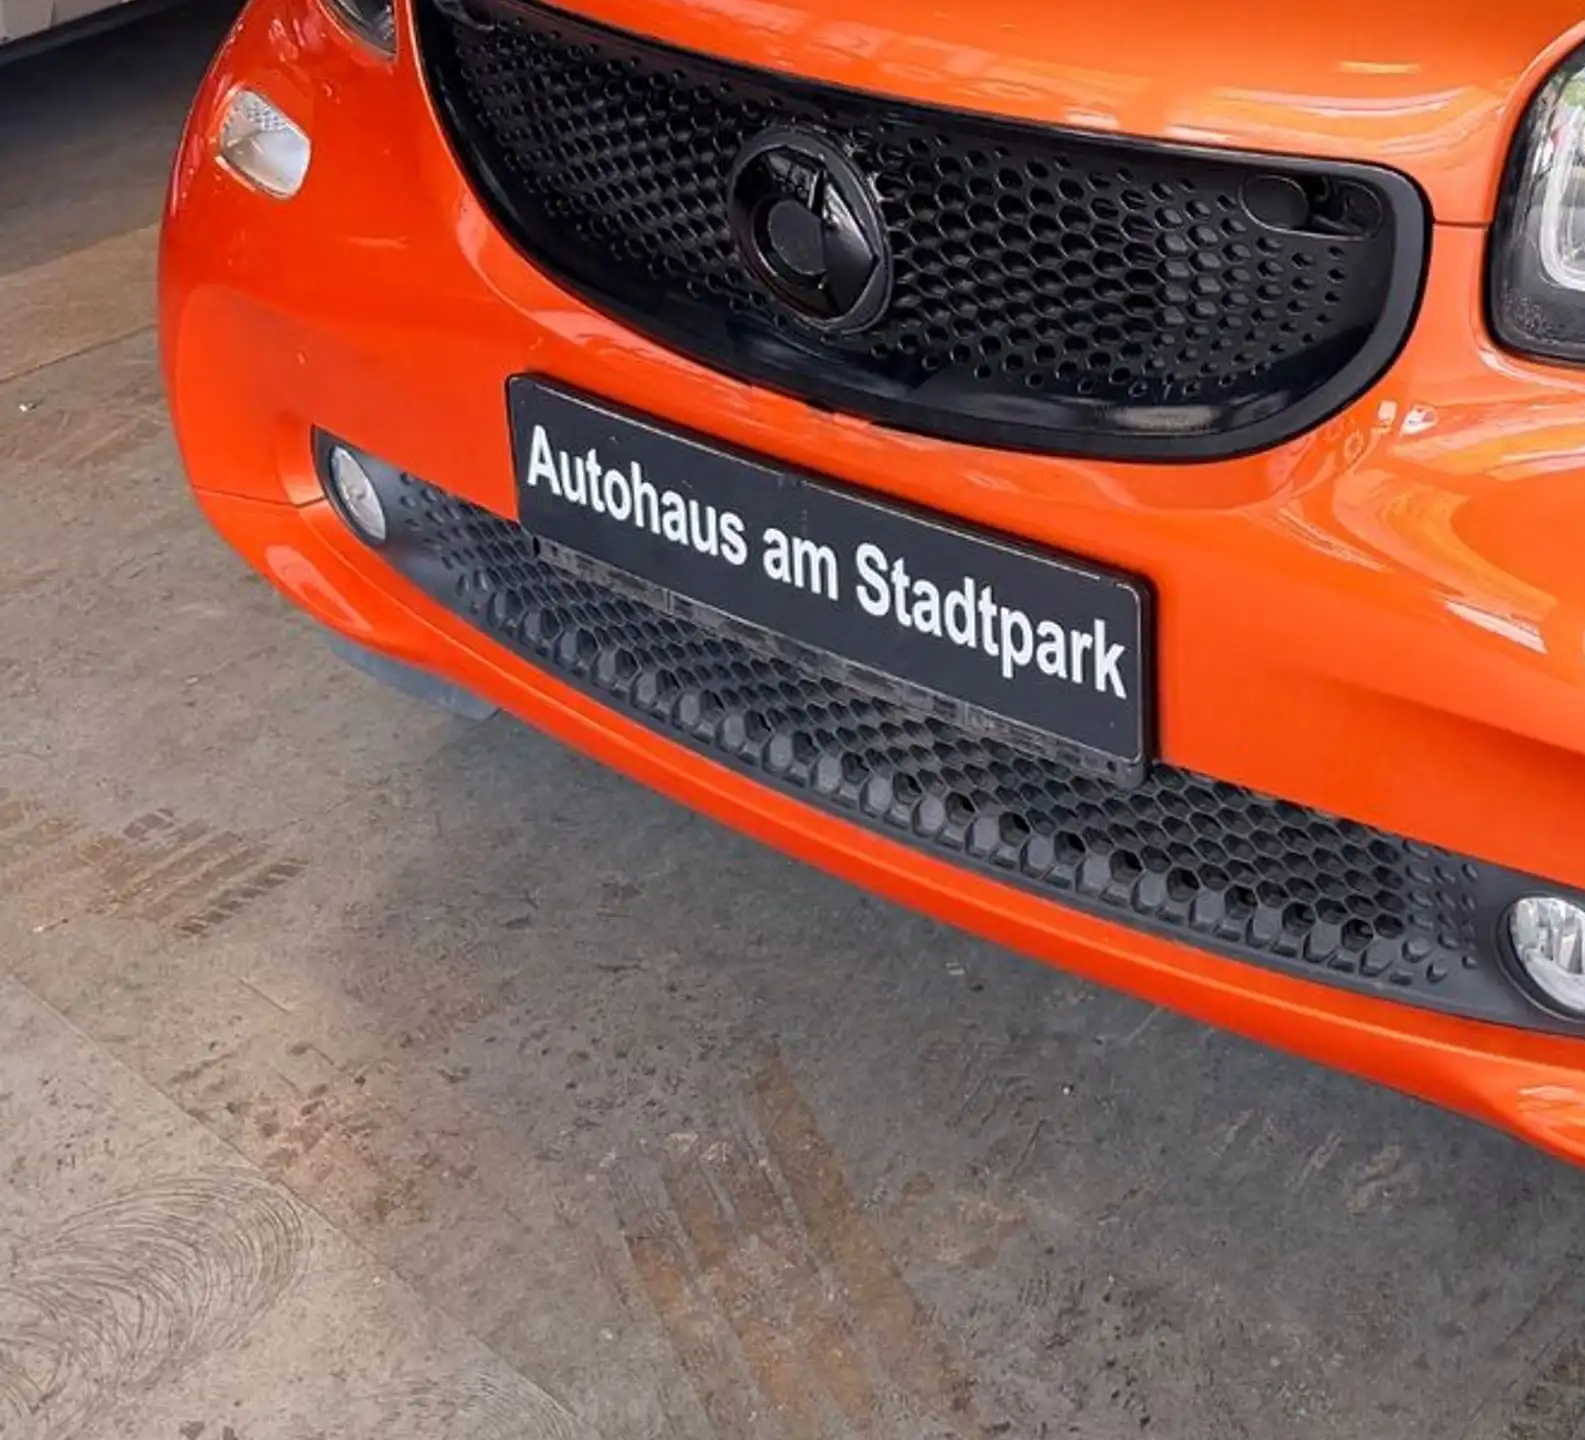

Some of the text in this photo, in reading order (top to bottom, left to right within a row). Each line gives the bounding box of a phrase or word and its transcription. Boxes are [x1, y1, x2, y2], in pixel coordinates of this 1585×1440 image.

[527, 424, 1127, 700] Autohaus am Stadtpark
